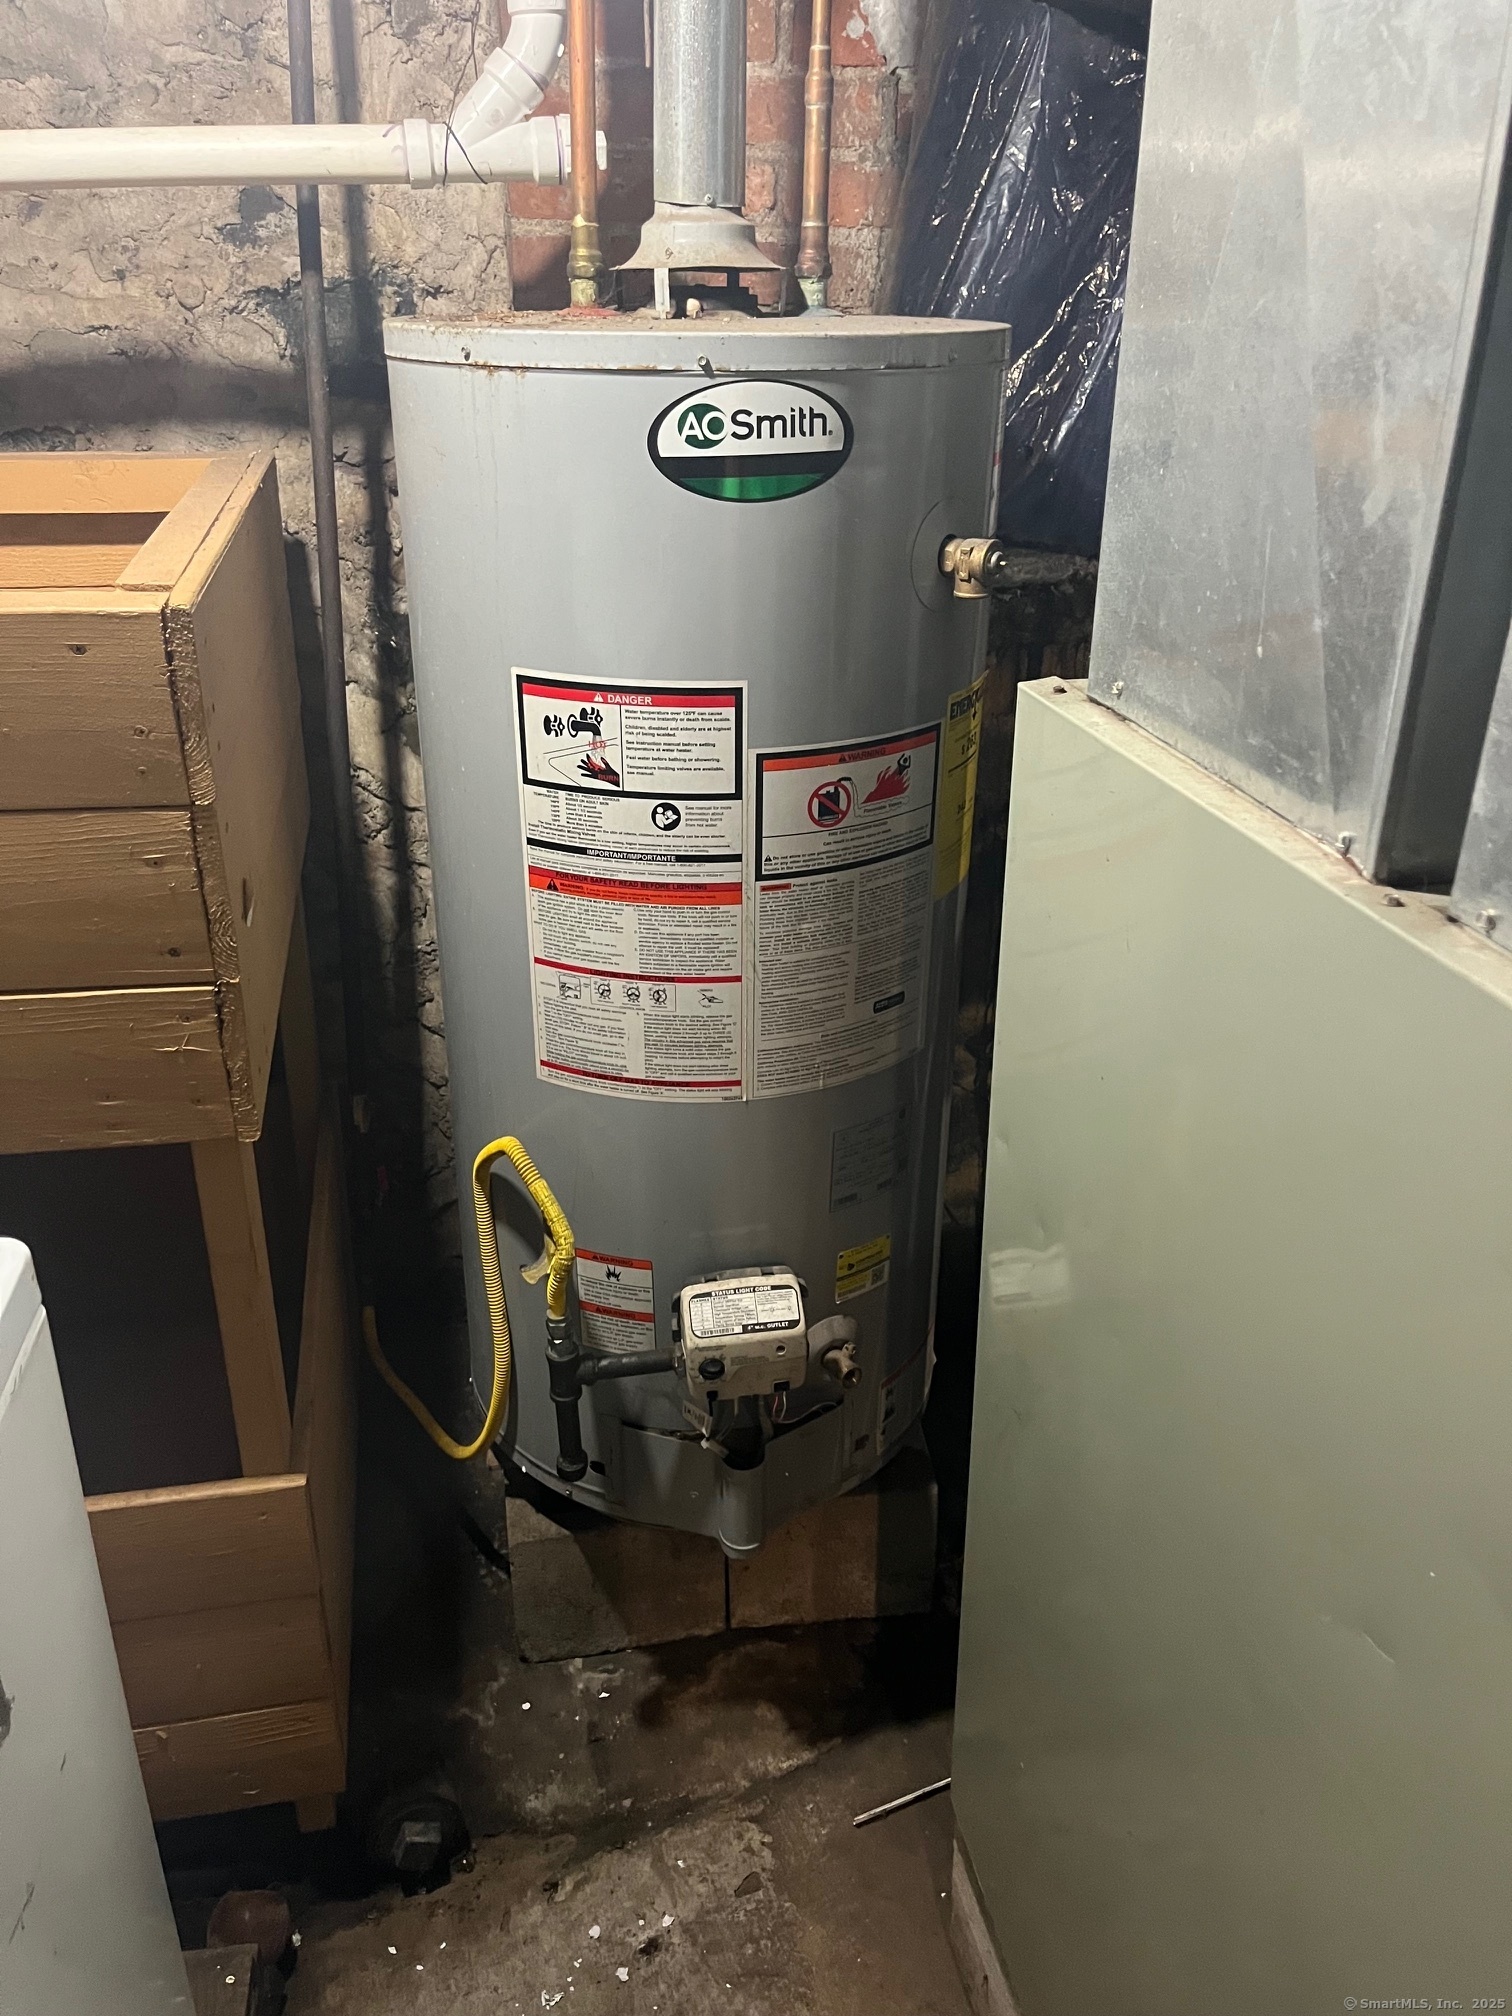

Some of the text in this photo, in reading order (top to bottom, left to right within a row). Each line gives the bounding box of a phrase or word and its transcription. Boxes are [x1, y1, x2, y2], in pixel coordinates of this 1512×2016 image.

[608, 695, 652, 705] DANGER
[848, 748, 886, 761] WARNING
[598, 774, 619, 782] BURN
[556, 871, 570, 879] FOR
[570, 873, 589, 882] YOUR
[590, 876, 616, 886] SAFETY
[619, 880, 638, 888] READ
[640, 882, 671, 890] BEFORE
[600, 1256, 633, 1266] WARNING
[603, 1309, 635, 1319] WARNING
